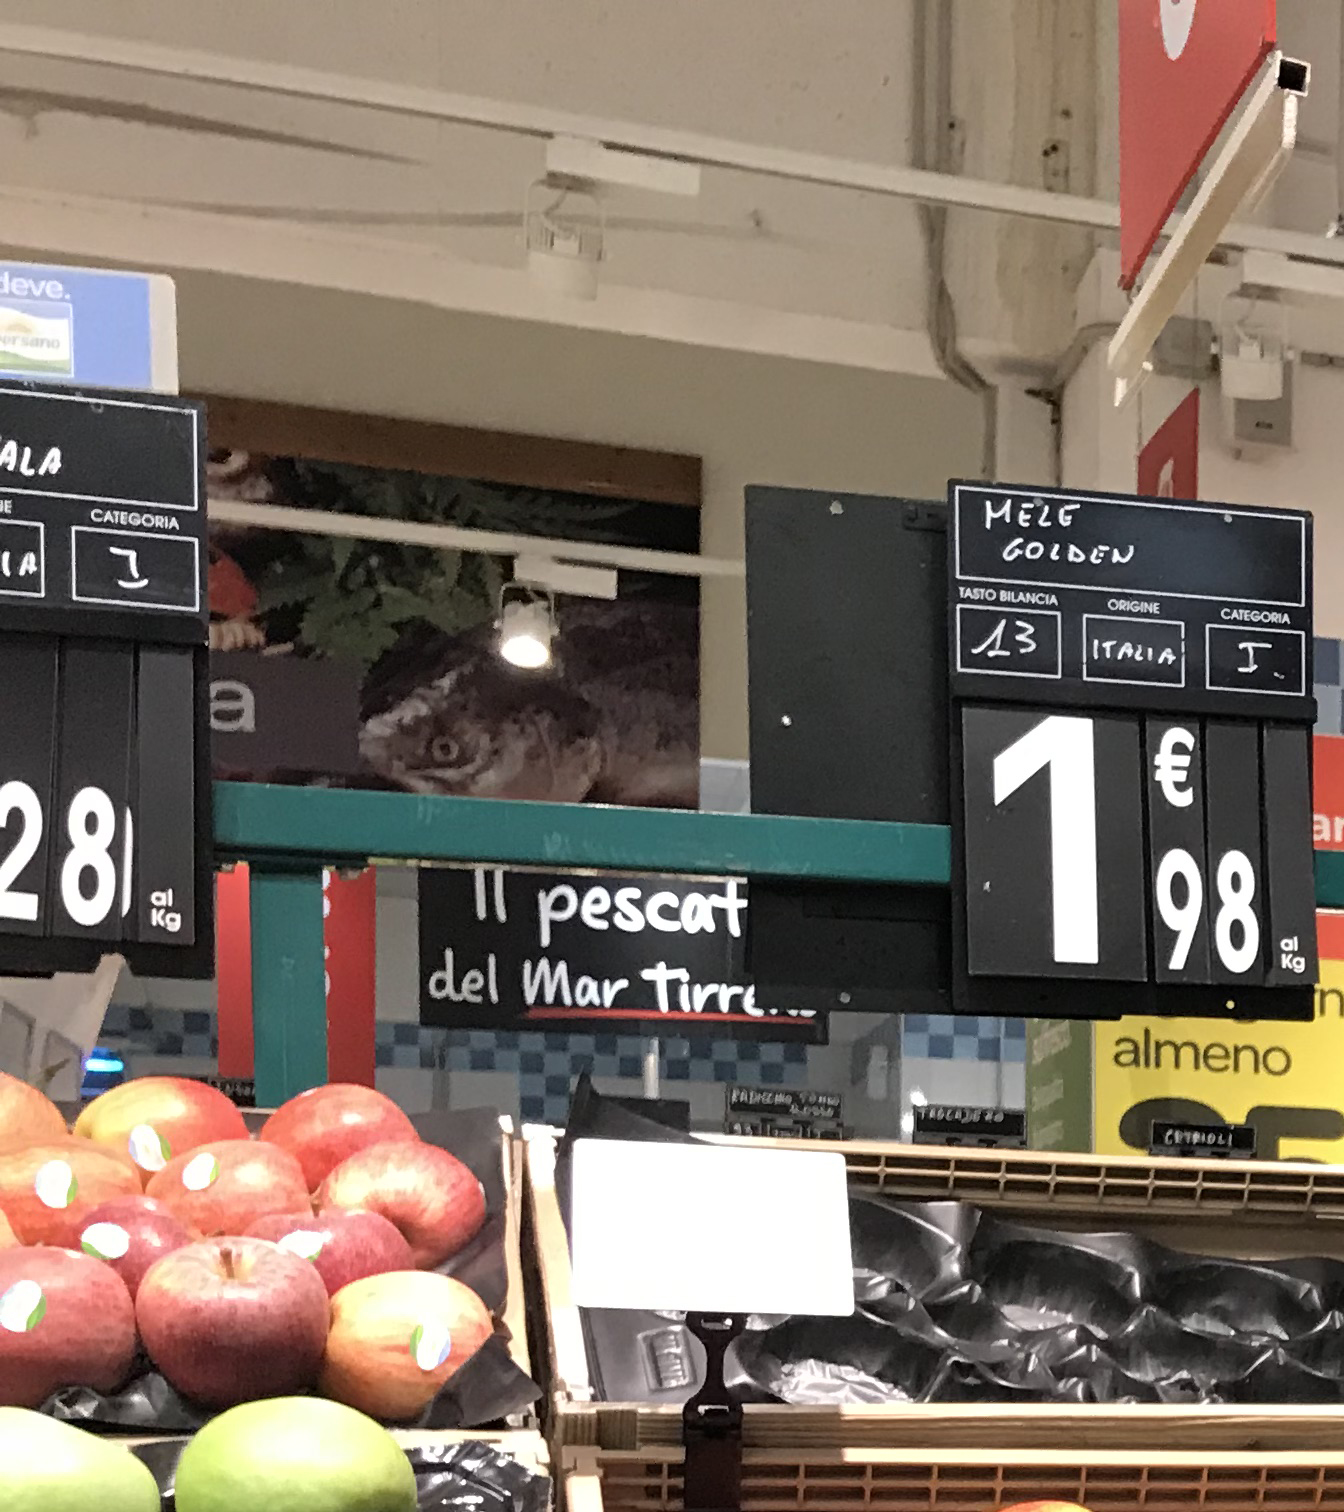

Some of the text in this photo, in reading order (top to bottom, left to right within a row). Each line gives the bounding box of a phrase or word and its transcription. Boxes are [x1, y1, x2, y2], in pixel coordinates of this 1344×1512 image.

[90, 509, 180, 531] CATEGORIA
[1002, 537, 1135, 564] GOLDEN
[958, 586, 1059, 606] TASTO BILANCIA
[1107, 599, 1161, 615] ORIGINE
[1220, 608, 1291, 626] CATEGORIA
[1093, 639, 1177, 665] ITALIA
[993, 715, 1099, 964] 1
[151, 908, 182, 932] Kg
[1155, 848, 1260, 974] 98
[428, 947, 499, 1004] del
[523, 956, 629, 1007] Mar
[1113, 1027, 1292, 1077] almeno
